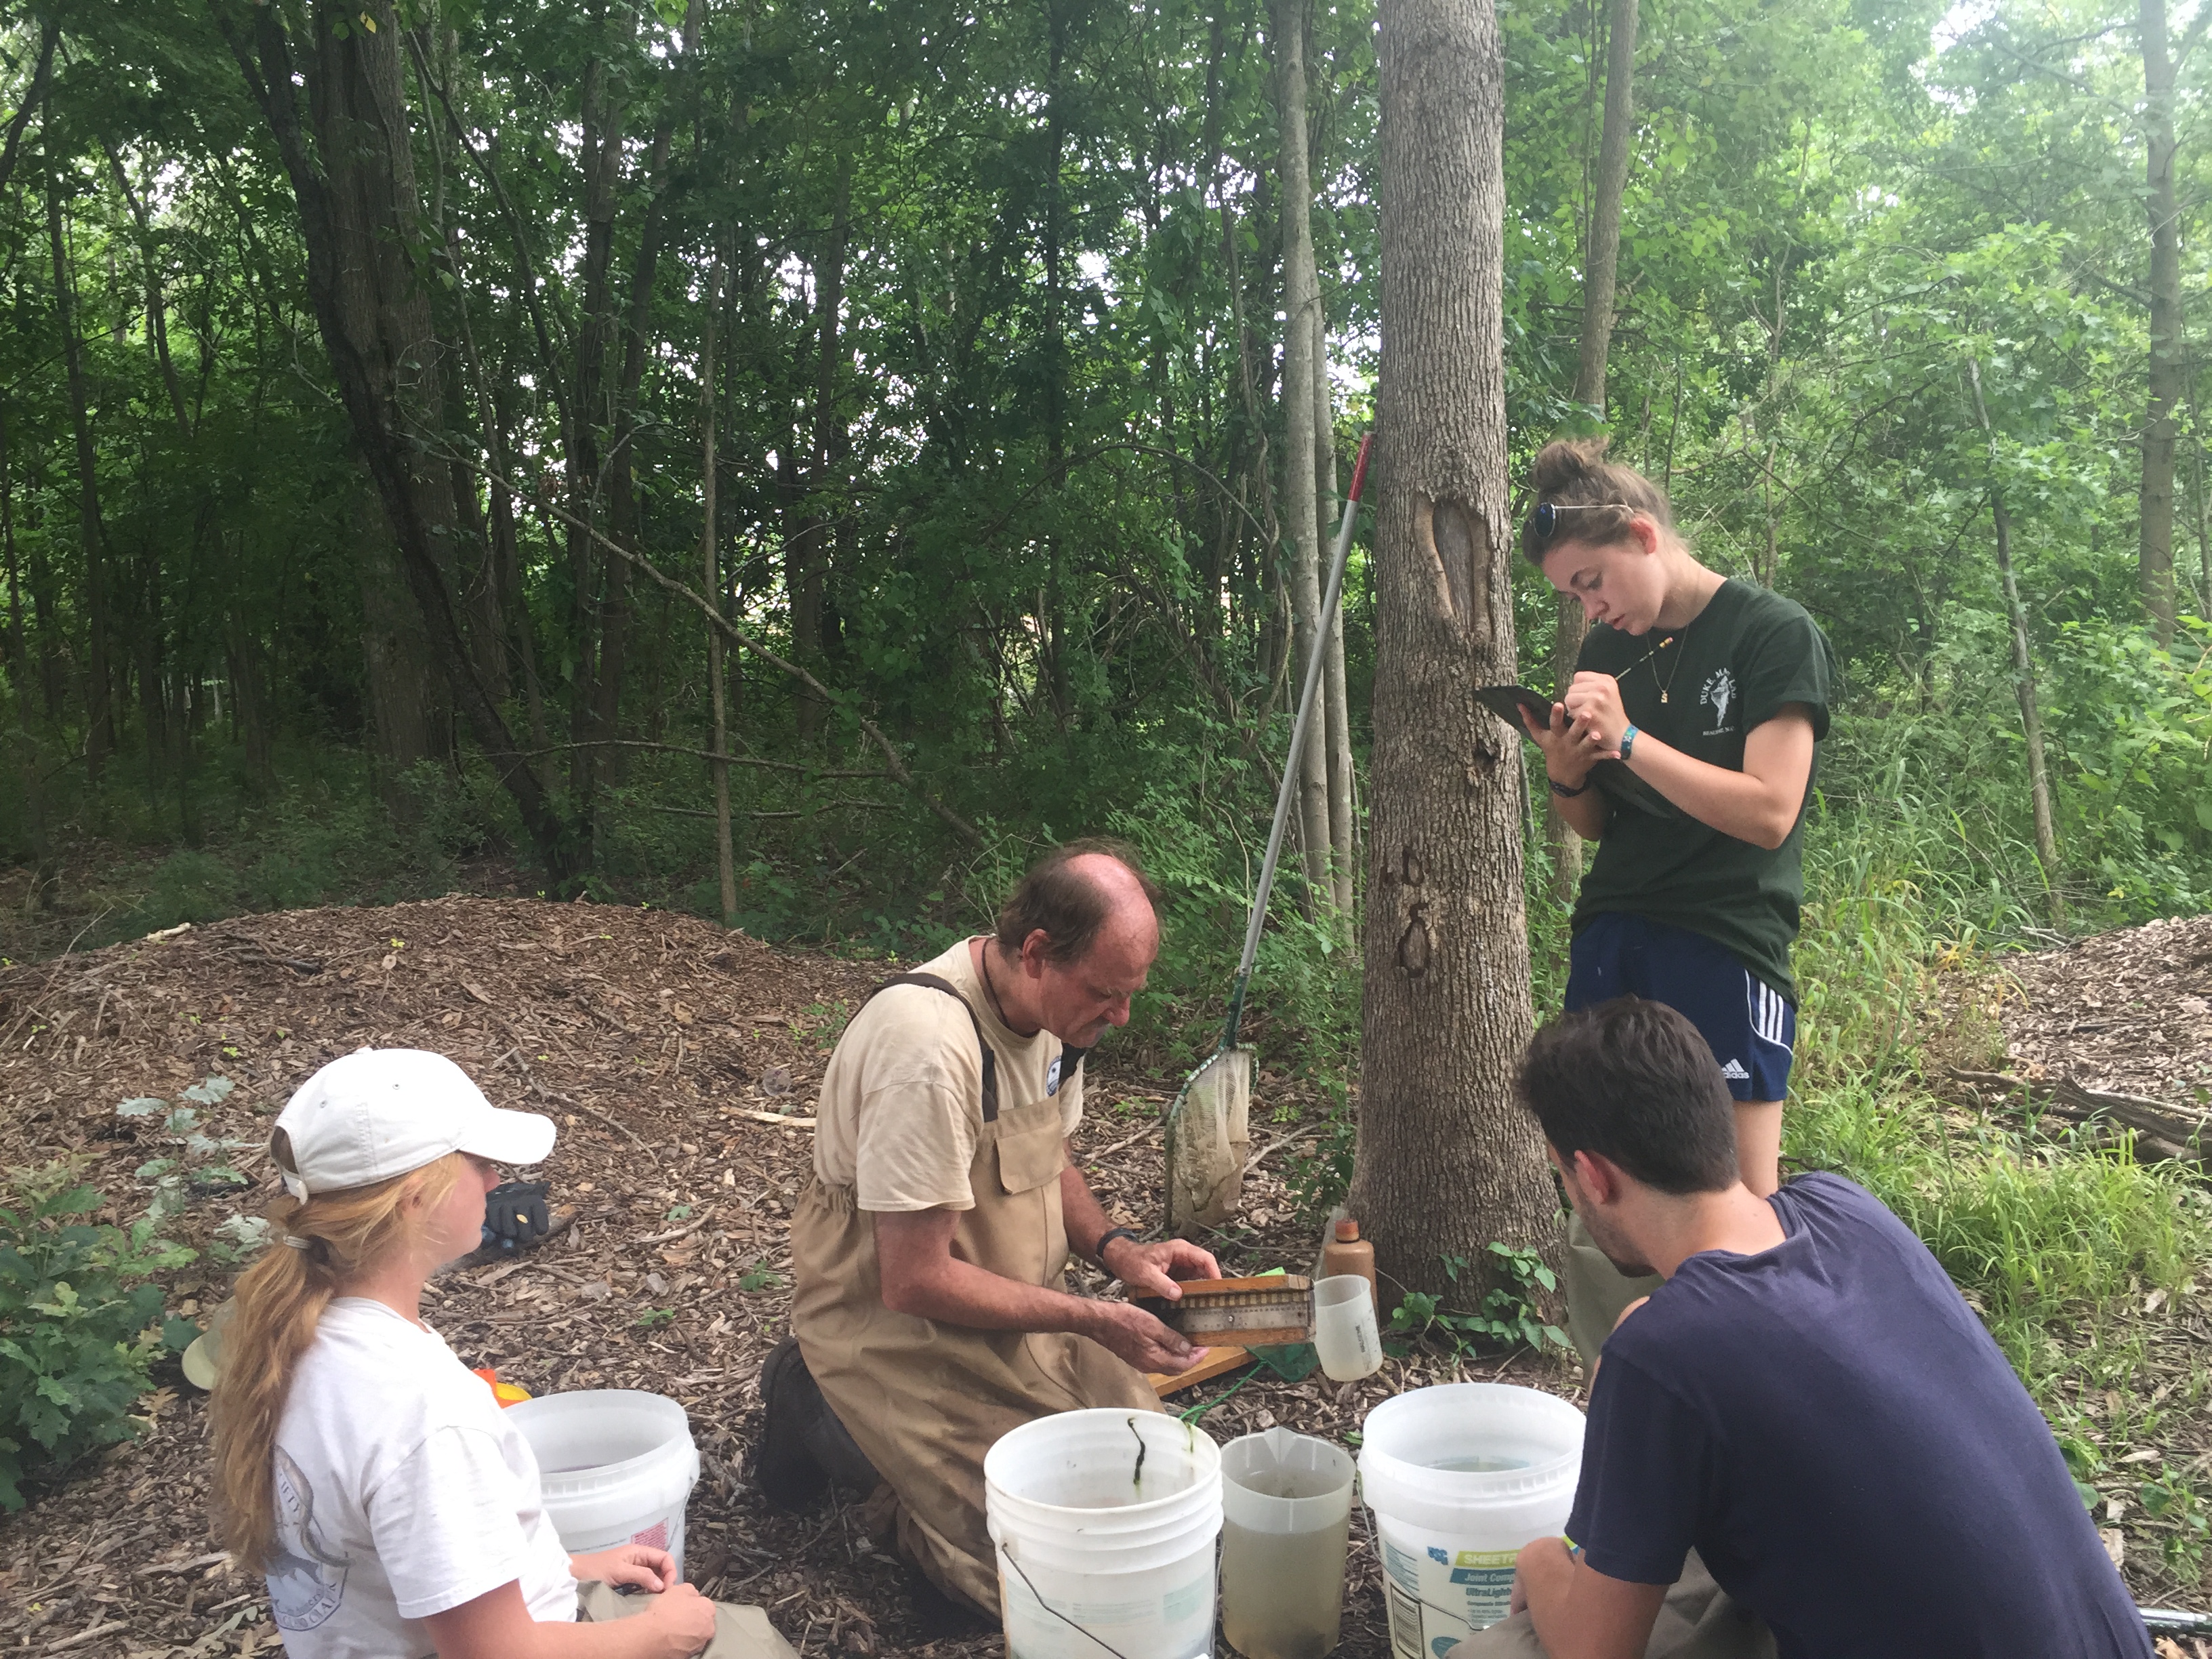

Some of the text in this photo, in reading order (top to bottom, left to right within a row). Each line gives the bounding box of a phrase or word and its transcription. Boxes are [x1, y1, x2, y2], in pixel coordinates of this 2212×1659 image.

[1700, 678, 1716, 705] DUKE
[1723, 1071, 1750, 1079] didas
[1465, 1573, 1488, 1582] Joint
